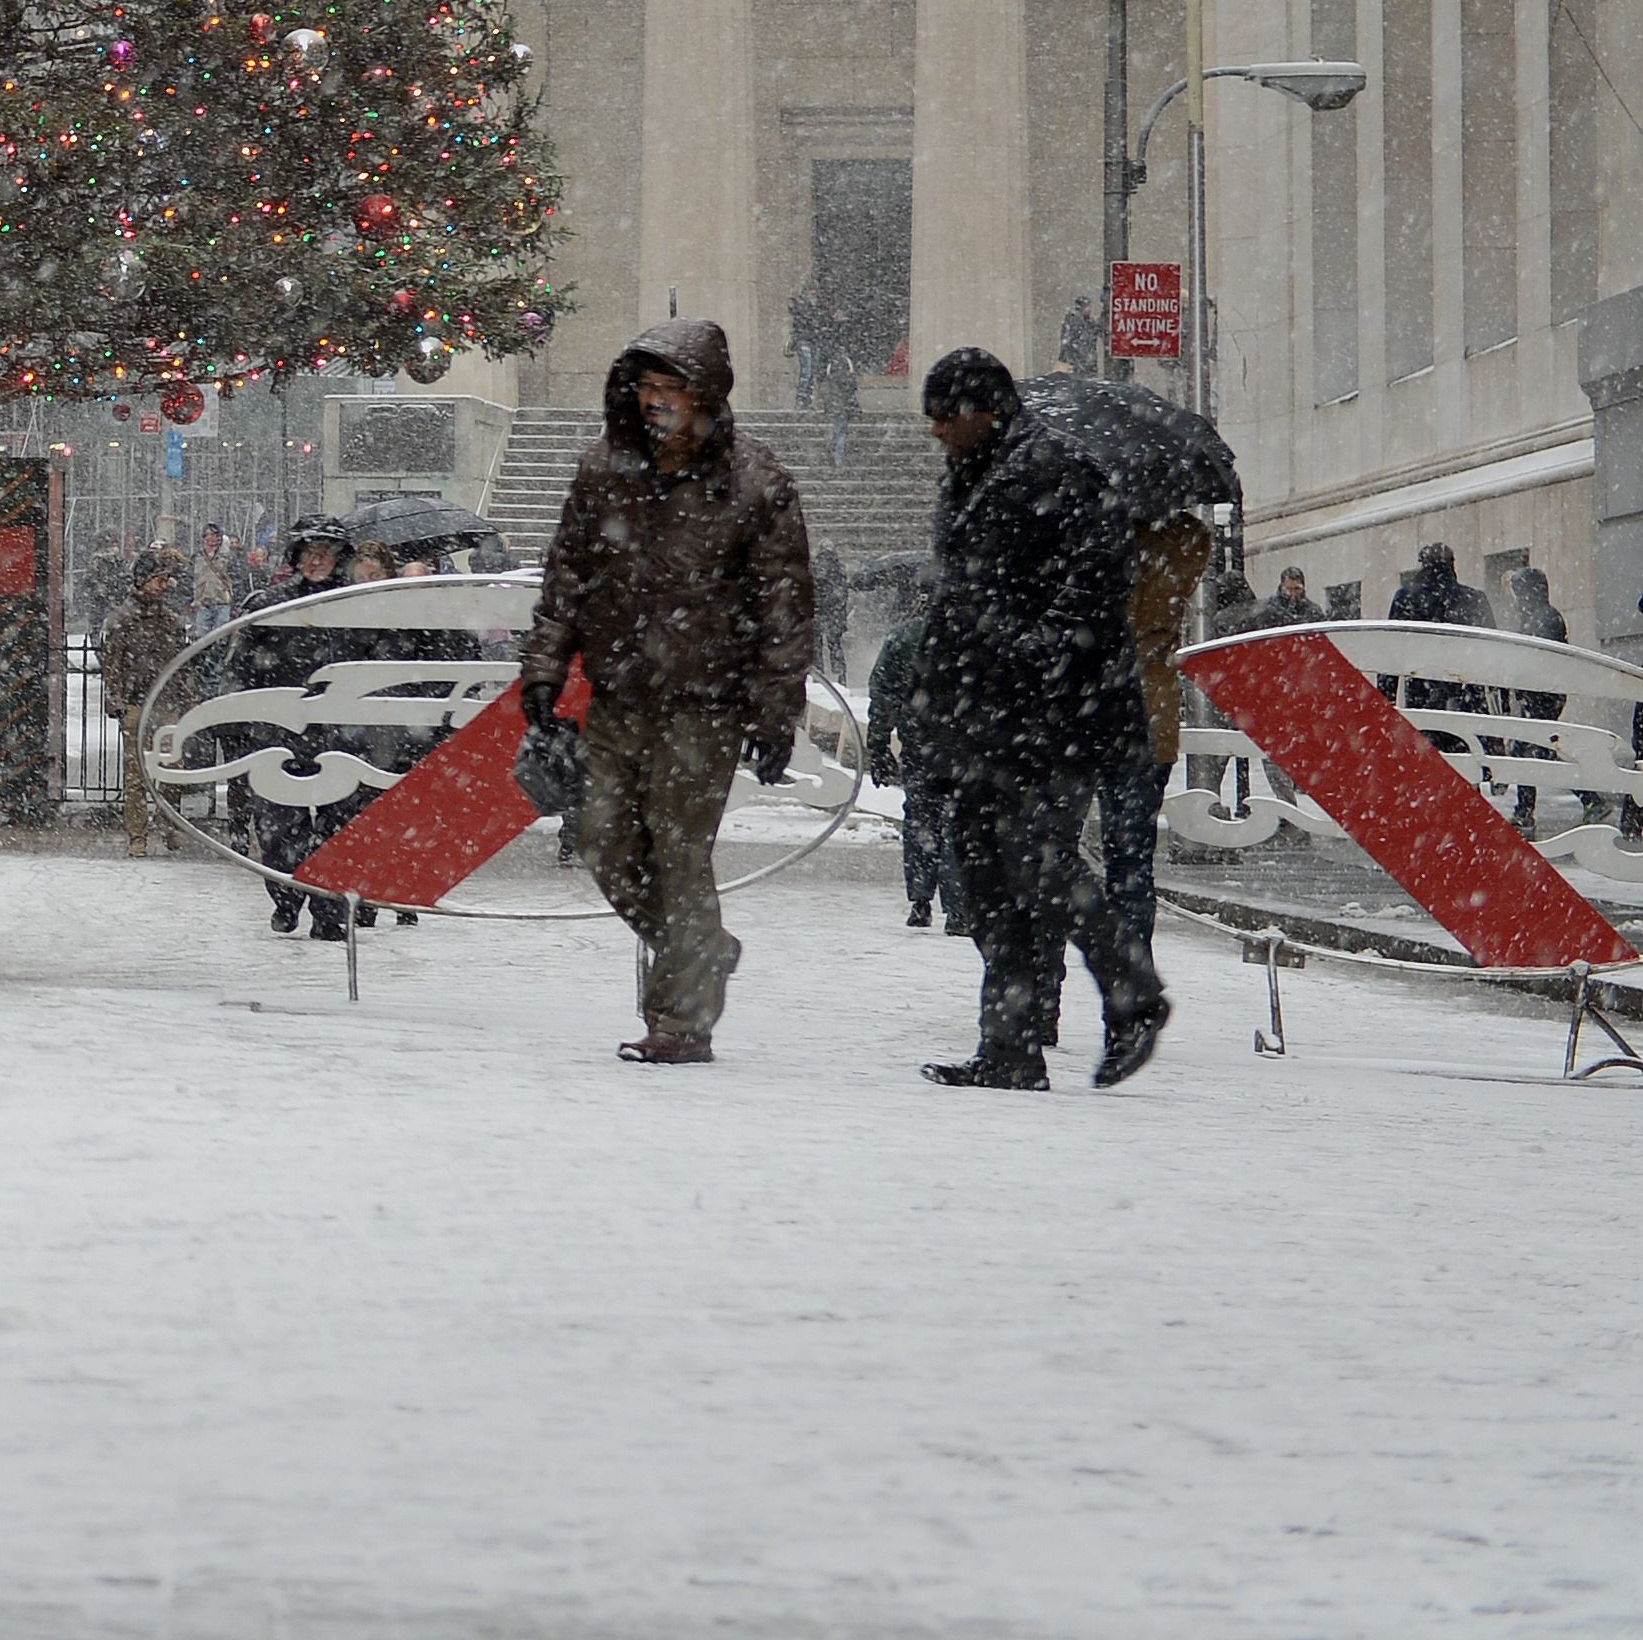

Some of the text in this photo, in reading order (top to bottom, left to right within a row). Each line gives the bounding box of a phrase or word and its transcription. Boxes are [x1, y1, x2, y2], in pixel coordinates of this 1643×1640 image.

[1134, 273, 1158, 292] NO
[1113, 297, 1179, 313] STANDING
[1117, 318, 1176, 334] ANYTIME
